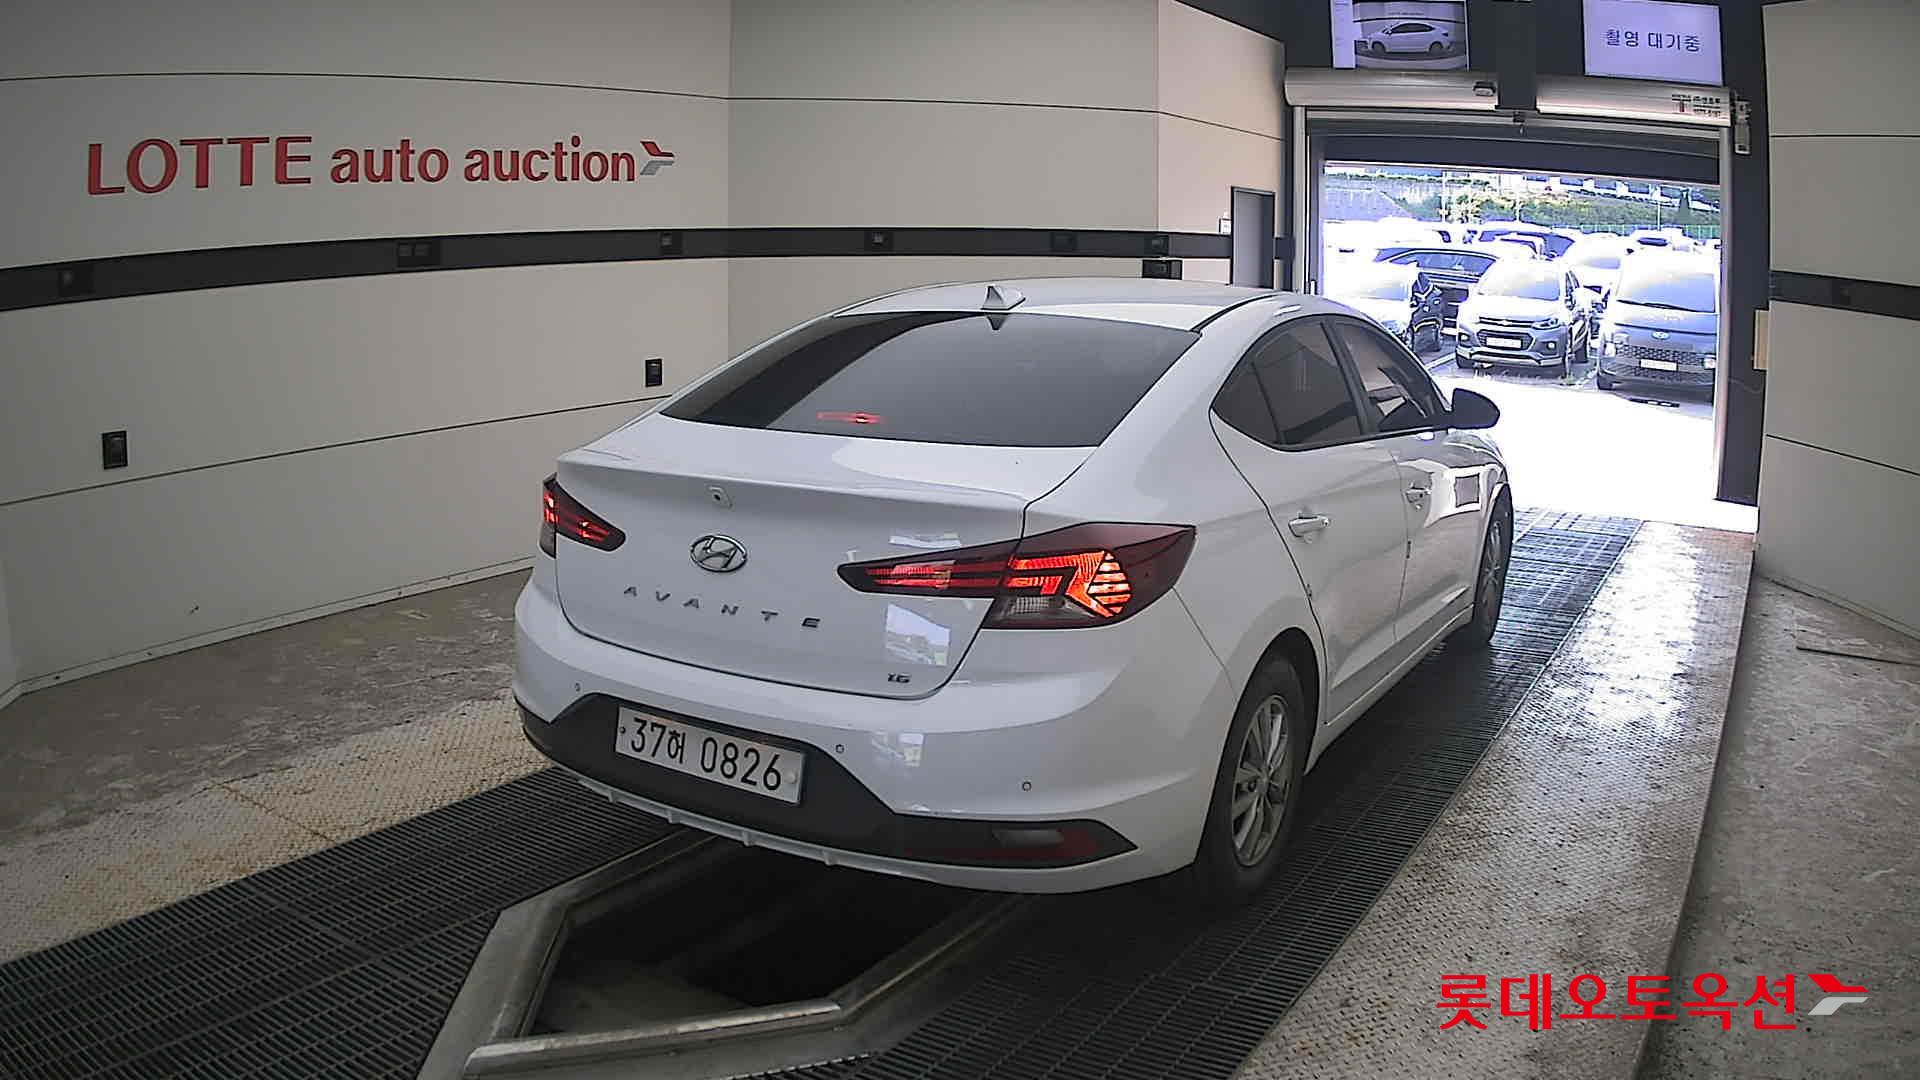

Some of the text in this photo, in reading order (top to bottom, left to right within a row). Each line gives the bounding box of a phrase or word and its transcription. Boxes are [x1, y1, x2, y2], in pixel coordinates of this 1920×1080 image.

[1648, 32, 1700, 52] 대기중
[87, 136, 636, 195] LOTTE auto auction
[623, 585, 821, 629] AVANTE
[631, 717, 781, 790] 37허 0826
